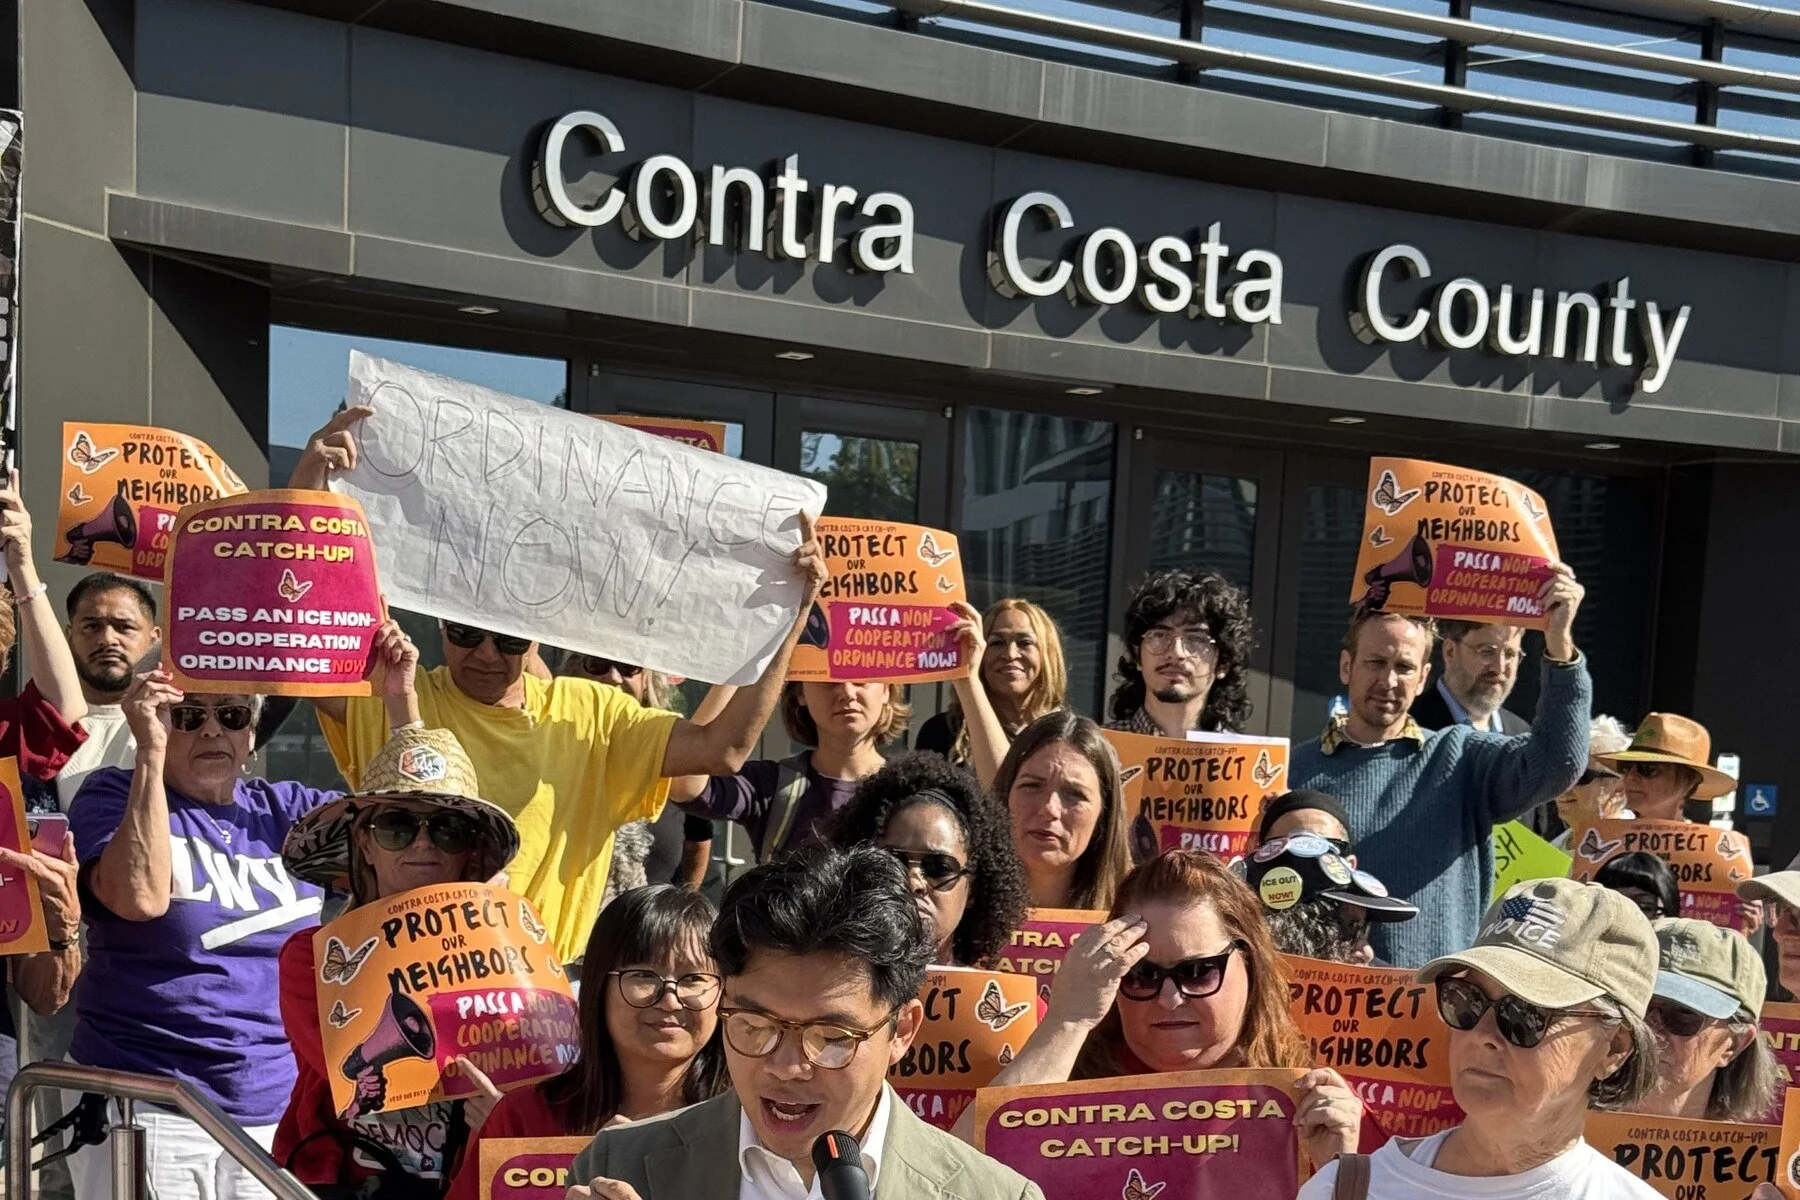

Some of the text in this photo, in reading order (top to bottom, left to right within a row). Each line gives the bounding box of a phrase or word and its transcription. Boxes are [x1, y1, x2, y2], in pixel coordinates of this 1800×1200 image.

[542, 110, 1693, 394] Contra Costa County
[159, 468, 178, 479] OUR
[359, 380, 803, 558] ORDINANCE
[117, 478, 222, 505] NEIGHBOR
[1424, 481, 1510, 508] PROTECT
[1458, 505, 1476, 516] OUR
[187, 514, 306, 534] CONTRA
[309, 516, 367, 538] COSTA
[1417, 517, 1521, 543] NEIGHBORS
[213, 541, 355, 563] CATCH-UP!
[817, 534, 908, 559] ROTECT
[426, 500, 699, 635] NOW!
[847, 559, 866, 571] OUR
[1454, 551, 1540, 575] PASS A NON-
[820, 570, 919, 599] EIGHBORS
[1446, 570, 1541, 594] COOPERATION
[1431, 588, 1505, 609] ORDINANCE
[178, 606, 377, 627] PASS AN ICE NON-
[849, 606, 942, 628] PASS A NON-
[199, 630, 362, 650] COOPERATION
[845, 629, 946, 650] COOPERATION
[179, 654, 367, 675] ORDINANCE NOW
[832, 649, 958, 669] ORDINANCE NOW!
[1146, 756, 1246, 783] PROTECT
[1184, 784, 1204, 796] OUR
[1140, 794, 1249, 823] NEIGHBORS
[1181, 832, 1218, 852] PASS
[1219, 834, 1230, 852] A
[1624, 832, 1709, 852] PROTECT
[1262, 875, 1298, 888] ICE OUT
[387, 898, 424, 915] CONTRA
[424, 890, 452, 906] COSTA
[381, 899, 510, 949] PROTECT
[1480, 918, 1562, 949] NO ICE
[441, 934, 468, 952] OUR
[387, 945, 536, 995] NEIGHBORS
[1294, 968, 1414, 986] CONTRA COSTA CATCH-UP!
[456, 991, 509, 1019] PASS
[510, 991, 525, 1014] A
[1333, 1019, 1360, 1033] OUR
[930, 1094, 945, 1118] A
[1381, 1085, 1395, 1106] A
[1398, 1087, 1454, 1112] NON-
[999, 1102, 1155, 1128] CONTRA
[1162, 1098, 1286, 1121] COSTA
[1039, 1134, 1240, 1159] CATCH-UP!
[1627, 1127, 1769, 1144] CONTRA COSTA CATCH-UP!
[1613, 1143, 1781, 1183] PROTECT
[1675, 1184, 1708, 1200] OUR
